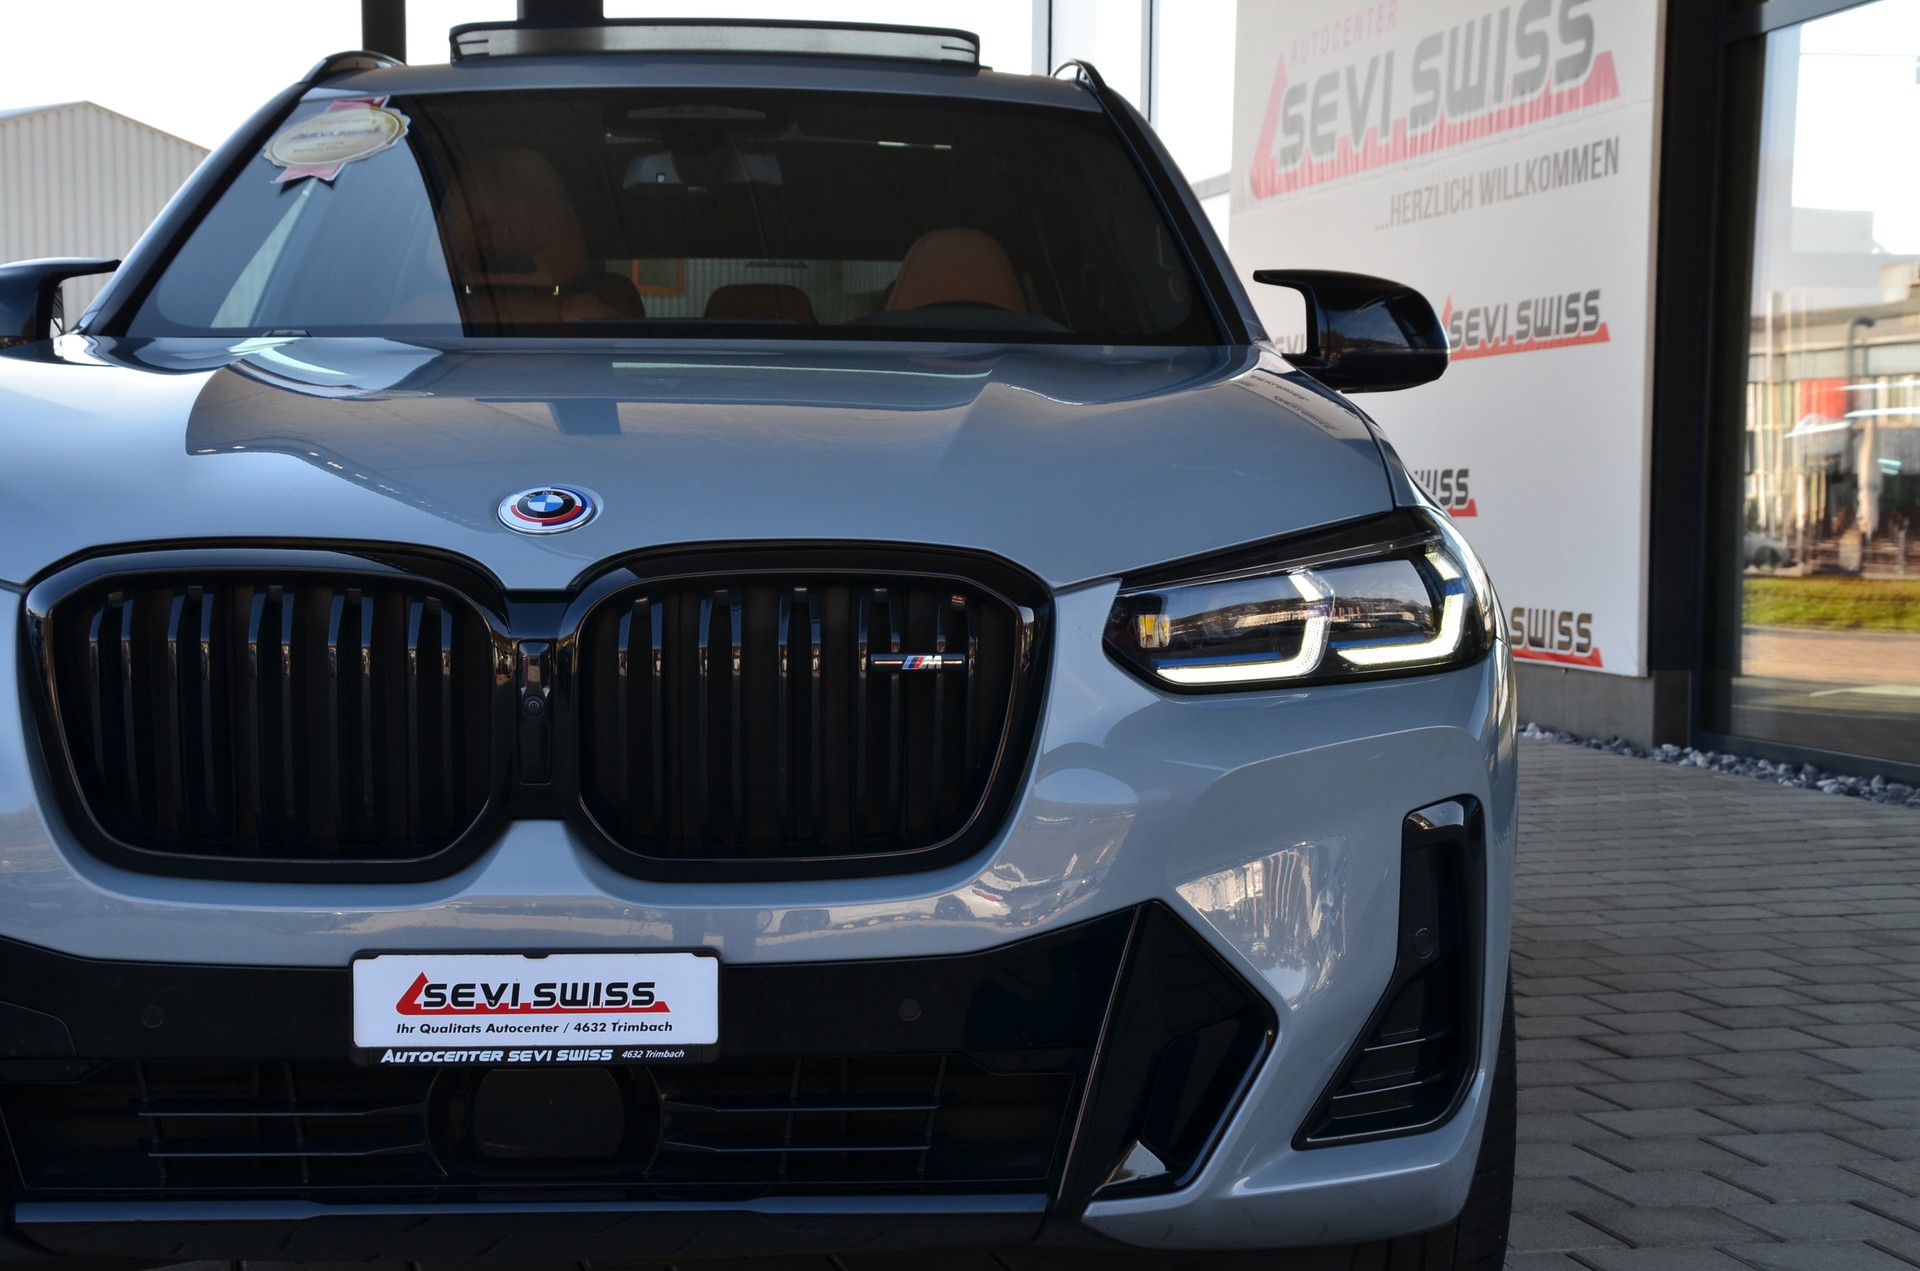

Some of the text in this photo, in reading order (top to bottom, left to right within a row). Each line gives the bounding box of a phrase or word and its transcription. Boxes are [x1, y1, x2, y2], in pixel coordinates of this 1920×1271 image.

[1289, 0, 1399, 68] AUTOCENTER
[1279, 0, 1595, 169] SEVI SWISS
[1478, 136, 1620, 210] WILLKOMMEN
[1449, 289, 1601, 348] SEVI SWISS
[1414, 468, 1469, 506] ISS
[1510, 607, 1592, 653] SWISS
[423, 981, 656, 1008] SEVI SWISS
[396, 1023, 415, 1034] Ihr
[419, 1022, 482, 1035] Qualitats
[485, 1022, 559, 1034] Autocenter
[573, 1022, 607, 1033] 4632
[611, 1021, 673, 1032] Trimbach
[380, 1049, 685, 1063] AUTOCENTER SEVI SWISS 4632 Trimbach
